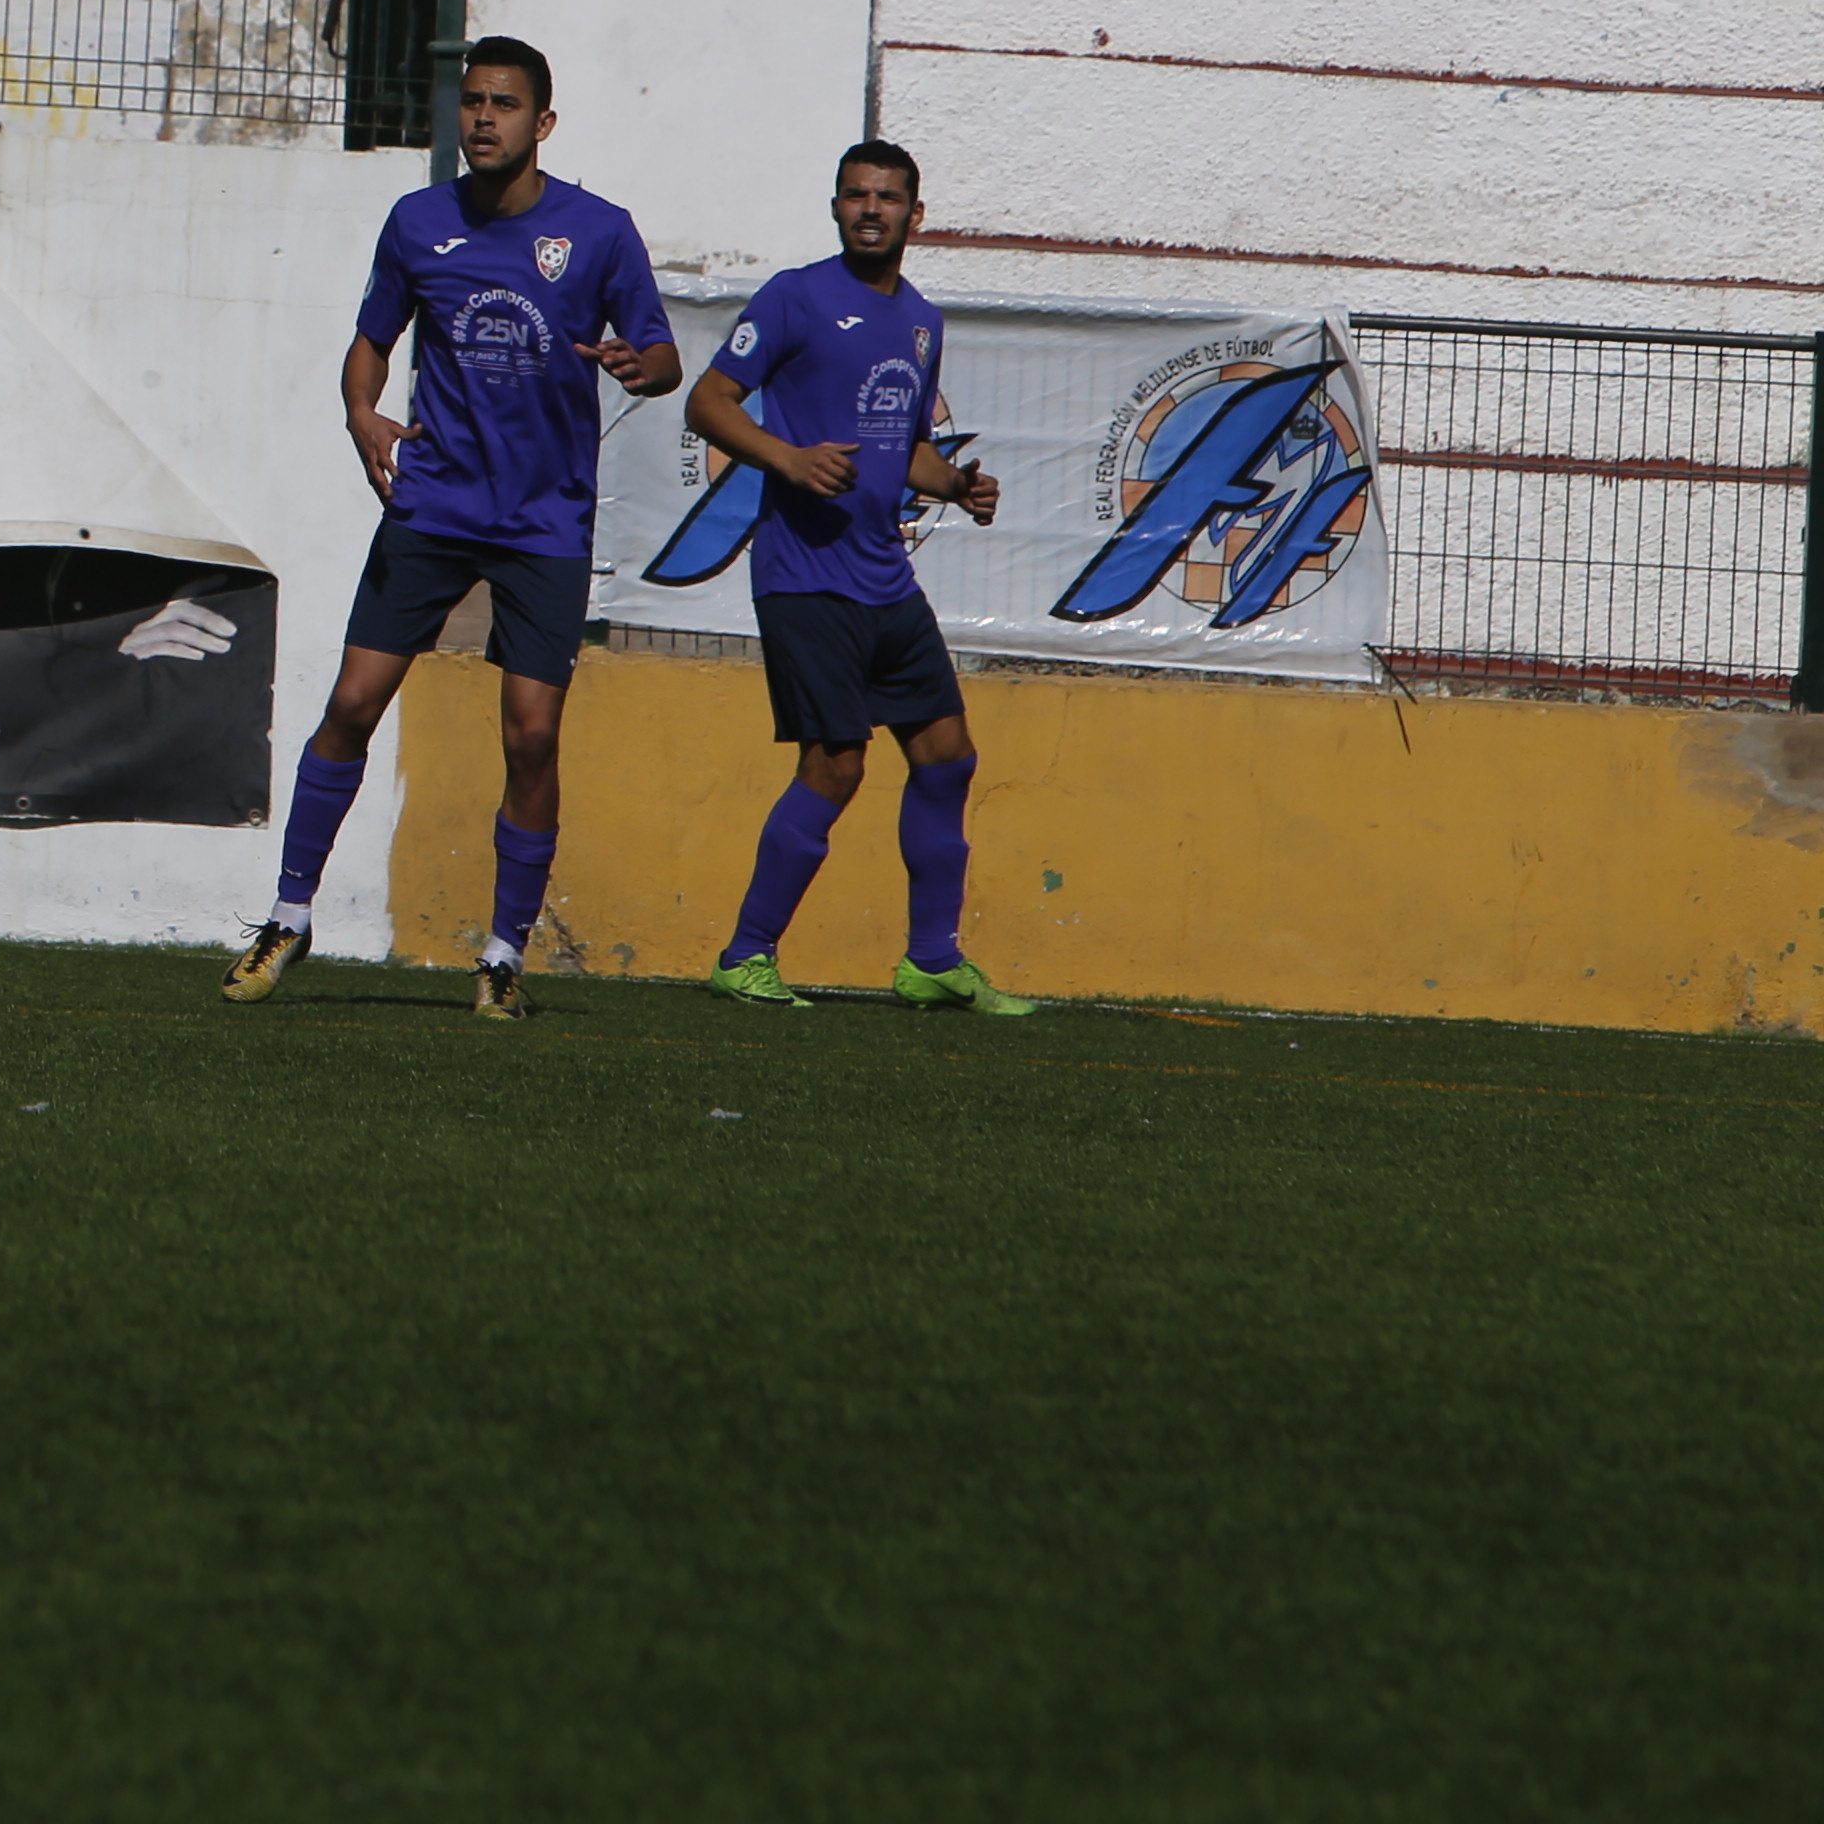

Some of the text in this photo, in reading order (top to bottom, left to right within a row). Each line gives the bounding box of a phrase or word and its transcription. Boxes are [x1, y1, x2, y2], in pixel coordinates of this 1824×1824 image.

[452, 289, 554, 353] #MeComprometo
[475, 316, 529, 347] 25N
[1095, 335, 1275, 521] REAL FEDERACIÓN MELILLENSE DE FÚTBOL
[680, 454, 701, 487] REAL
